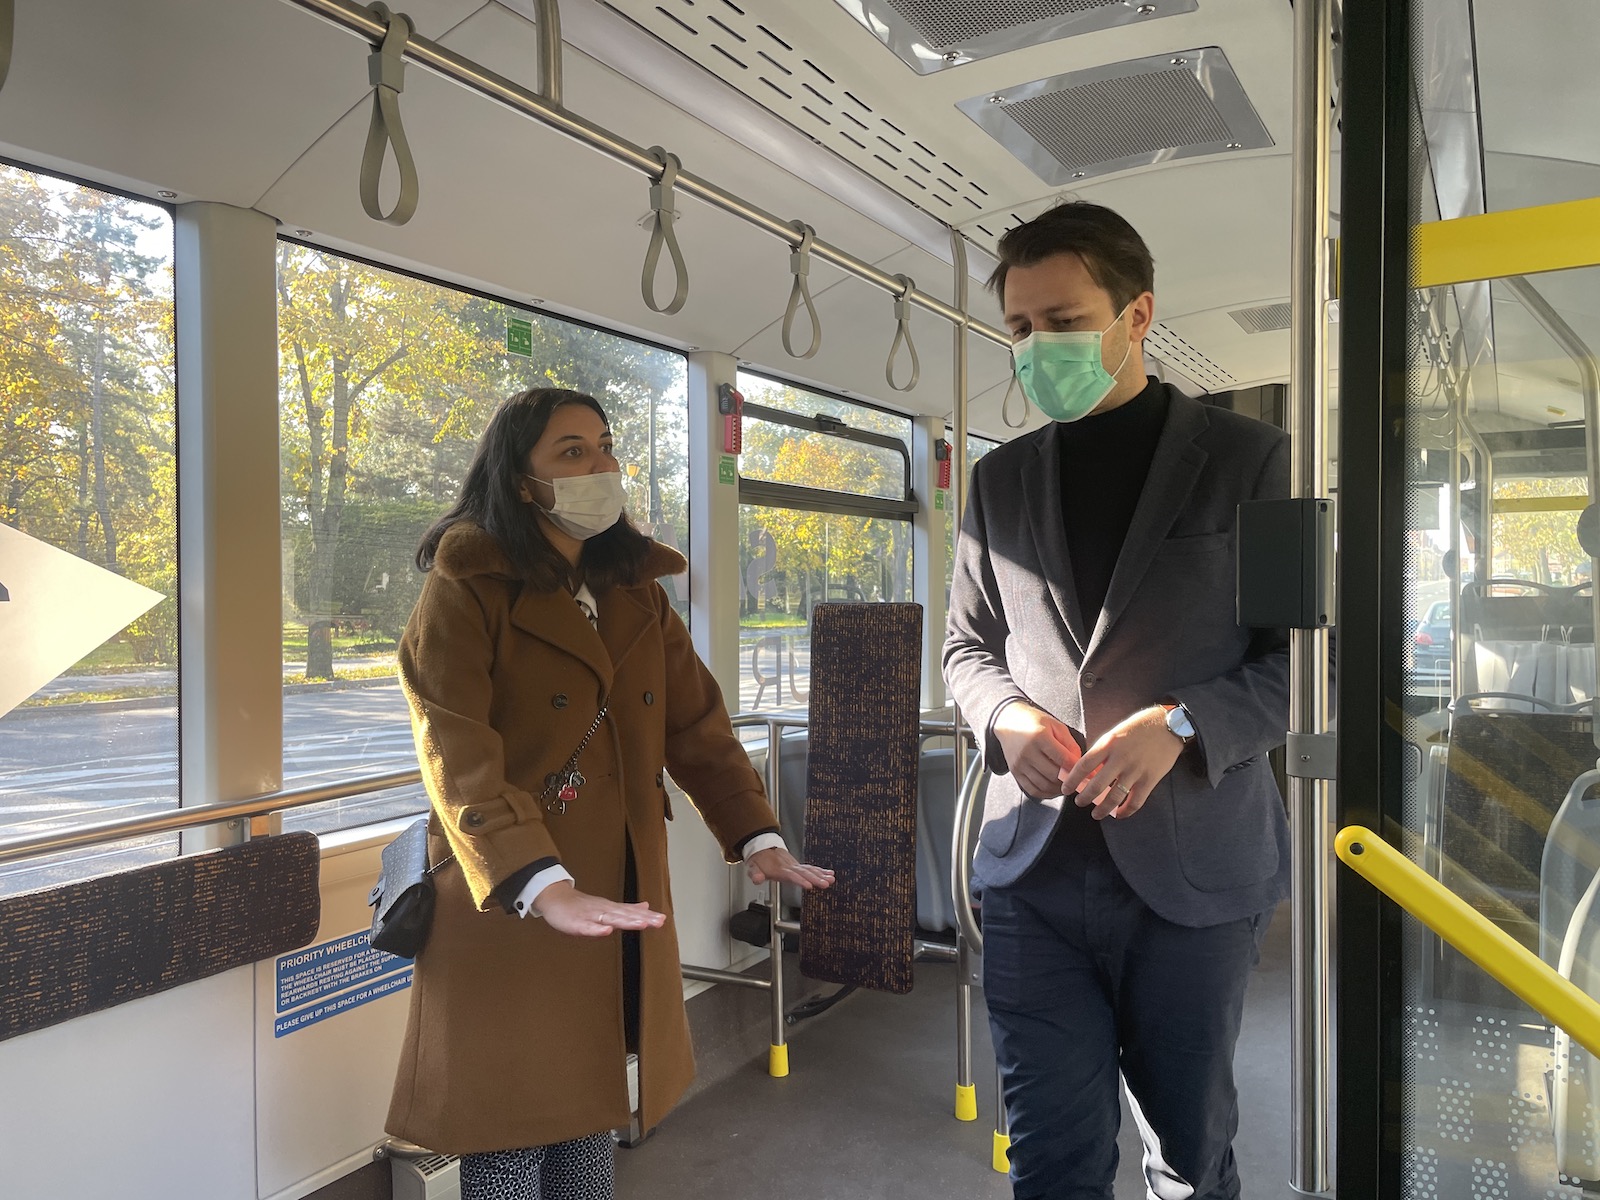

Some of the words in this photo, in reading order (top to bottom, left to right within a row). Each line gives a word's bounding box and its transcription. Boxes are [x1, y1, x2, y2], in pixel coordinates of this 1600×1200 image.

[281, 949, 324, 970] PRIORITY
[326, 934, 370, 955] WHEELCH
[281, 976, 294, 984] THIS
[296, 968, 315, 980] SPACE
[323, 956, 352, 970] RESERVED
[281, 982, 318, 999] REARWARDS
[319, 972, 343, 985] RESTING
[345, 964, 368, 976] AGAINST
[291, 986, 322, 1002] BACKREST
[324, 981, 338, 990] WITH
[351, 968, 373, 980] BRAKES
[294, 970, 331, 987] WHEELCHAIR
[333, 964, 349, 973] MUST
[358, 953, 379, 964] PLACED
[276, 1017, 299, 1032] PLEASE
[300, 1012, 314, 1022] GIVE
[315, 1008, 323, 1016] UP
[324, 1003, 336, 1013] THIS
[338, 996, 355, 1008] SPACE
[356, 992, 367, 1001] FOR
[373, 977, 406, 994] WHEELCHAIR
